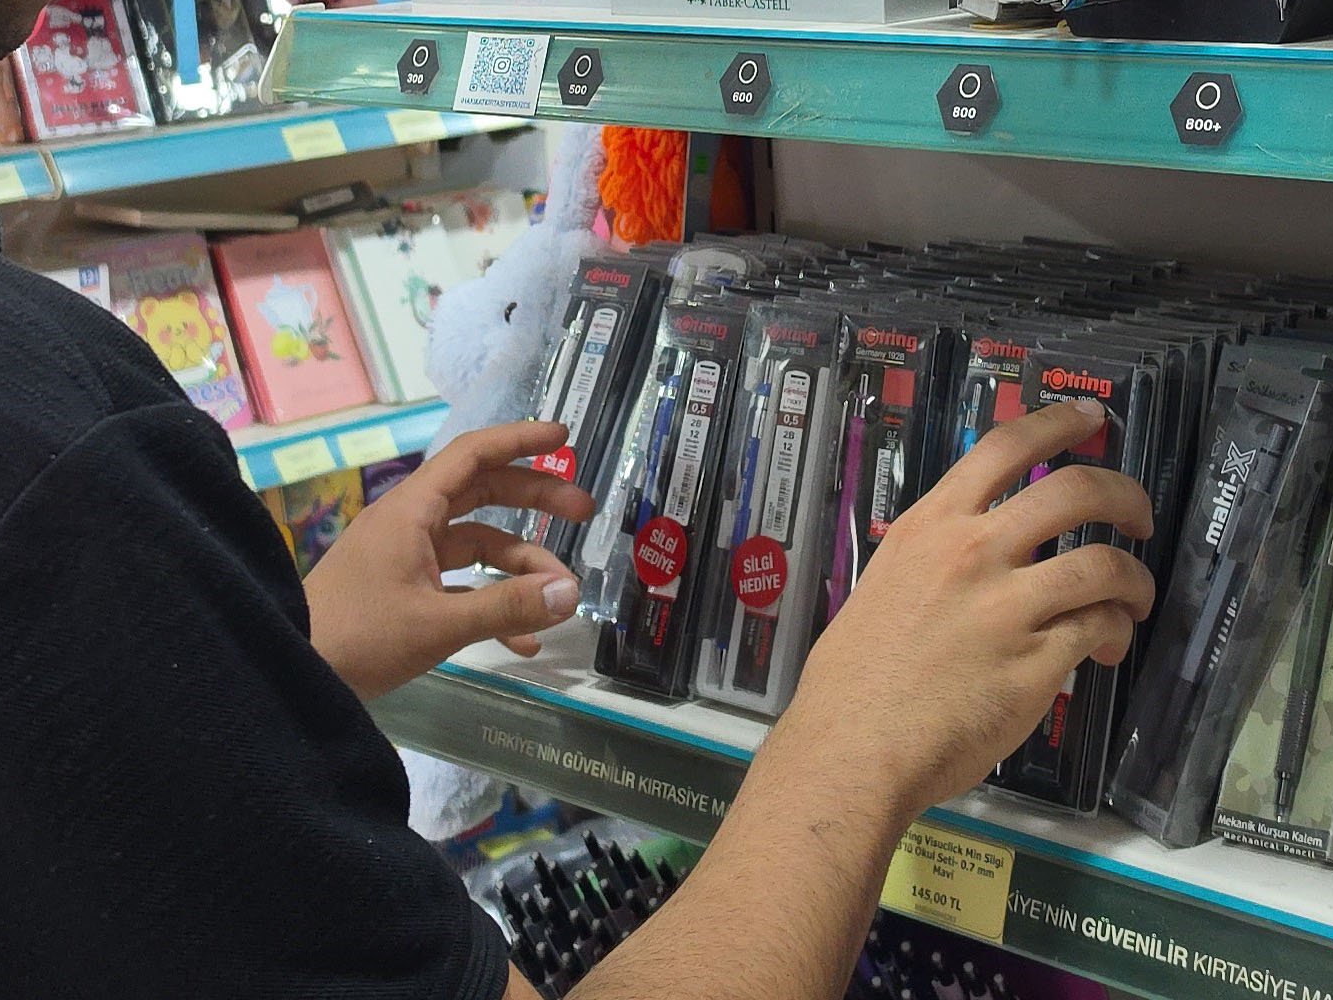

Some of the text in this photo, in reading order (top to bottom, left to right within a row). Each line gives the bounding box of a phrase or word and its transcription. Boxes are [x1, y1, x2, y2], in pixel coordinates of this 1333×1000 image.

[407, 73, 423, 84] 300
[569, 84, 587, 95] 500
[732, 92, 752, 103] 600
[953, 107, 976, 119] 800
[1185, 119, 1221, 134] 800+
[857, 325, 918, 352] rotring
[855, 347, 886, 358] Germany
[1042, 368, 1113, 397] rotring
[691, 404, 706, 414] 0,5
[784, 416, 798, 425] 0,5
[690, 430, 699, 438] 12
[783, 431, 794, 439] 2B
[783, 442, 793, 450] 12
[649, 528, 678, 551] SİLGİ
[637, 544, 675, 575] HEDİYE
[744, 552, 773, 574] SİLGİ
[739, 573, 781, 595] HEDİYE
[563, 750, 636, 790] GÜVENİLİR
[638, 774, 708, 813] KIRTASİYE
[1218, 814, 1322, 848] Mekanik Kurşun Kalem
[925, 835, 1004, 869] Visuclick Min Silgi
[1224, 832, 1315, 858] Mechanical Pencil
[915, 846, 935, 861] Okul
[960, 860, 974, 872] 0.7
[977, 867, 994, 878] mm
[933, 866, 954, 880] Mavi
[912, 886, 961, 911] 145,00 TL
[1081, 917, 1297, 1000] GÜVENİLİR KIRTASİYE
